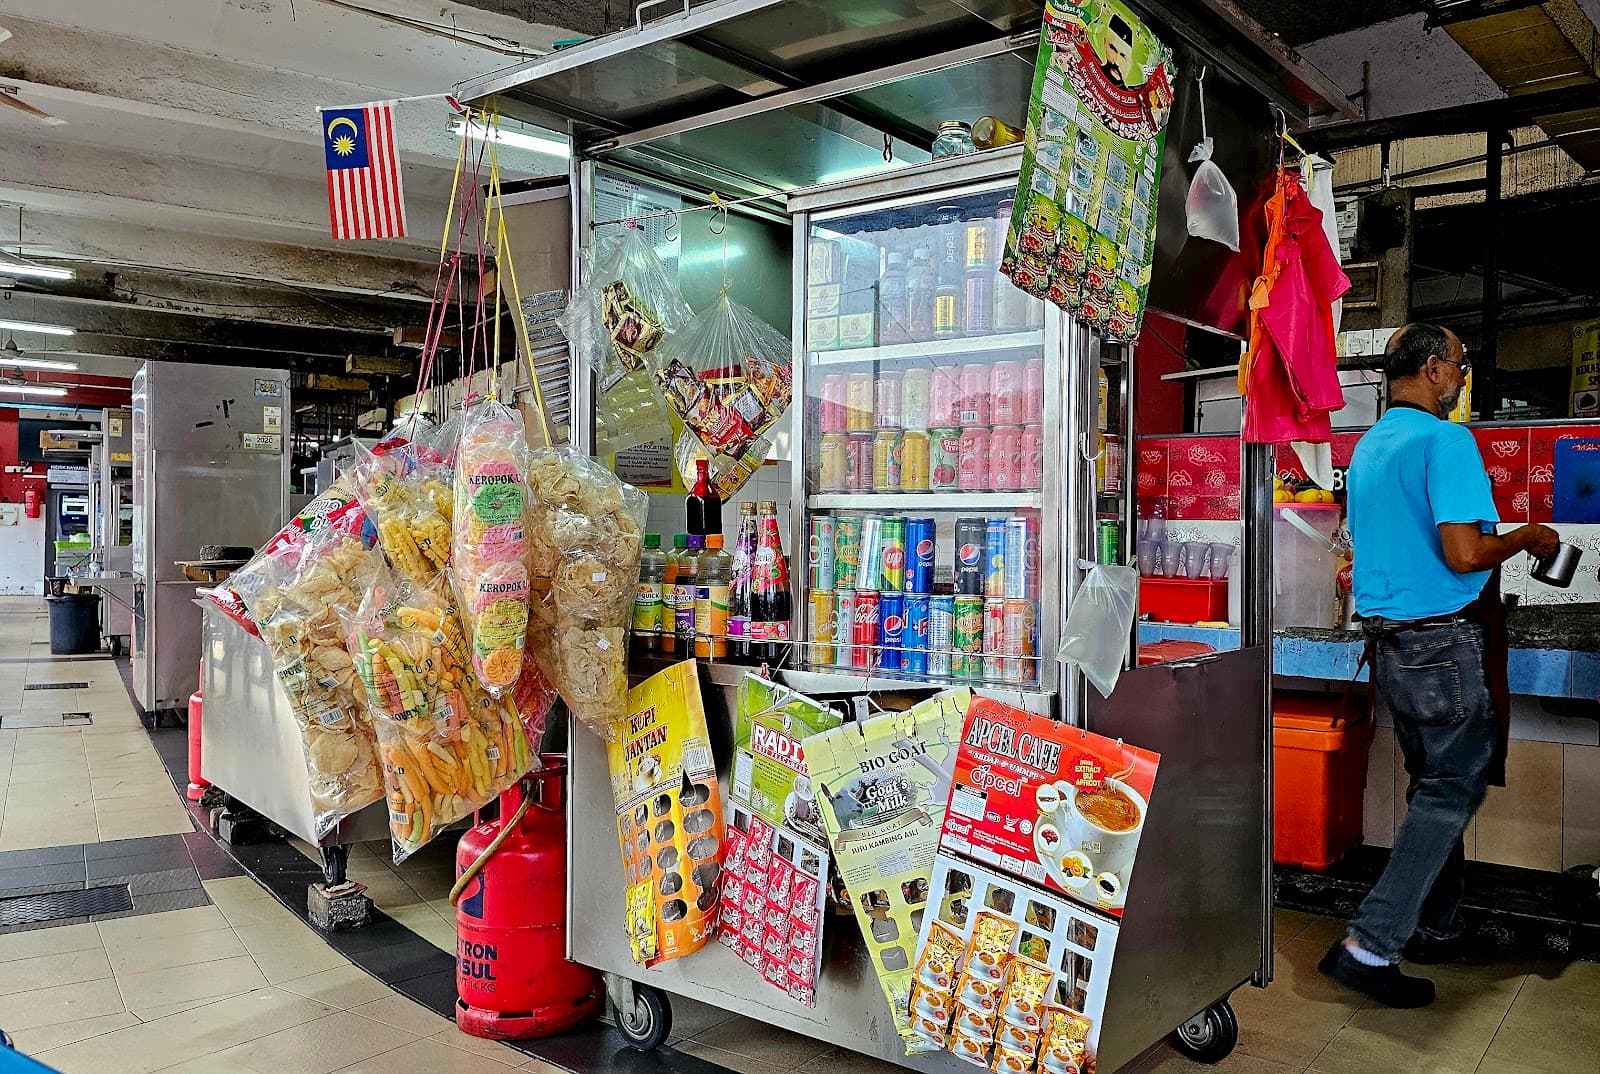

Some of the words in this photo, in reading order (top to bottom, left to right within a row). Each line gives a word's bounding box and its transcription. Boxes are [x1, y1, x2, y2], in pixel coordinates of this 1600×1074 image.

[469, 474, 514, 486] KEROPOK
[960, 565, 979, 574] pepsi
[480, 582, 521, 593] KEROPOK
[854, 604, 880, 624] Cola
[884, 637, 902, 645] pepsi
[630, 707, 656, 736] KOPI
[624, 723, 668, 763] JANTAN
[754, 722, 806, 765] RADI
[964, 716, 1017, 759] APCEL
[1017, 733, 1062, 775] CAFE
[859, 756, 885, 774] BIO
[889, 740, 928, 764] GOAT
[1075, 766, 1101, 774] EXTRACT
[866, 779, 908, 800] Goat's
[876, 794, 908, 814] Milk
[868, 833, 904, 850] KAMBING
[481, 983, 496, 993] KG
